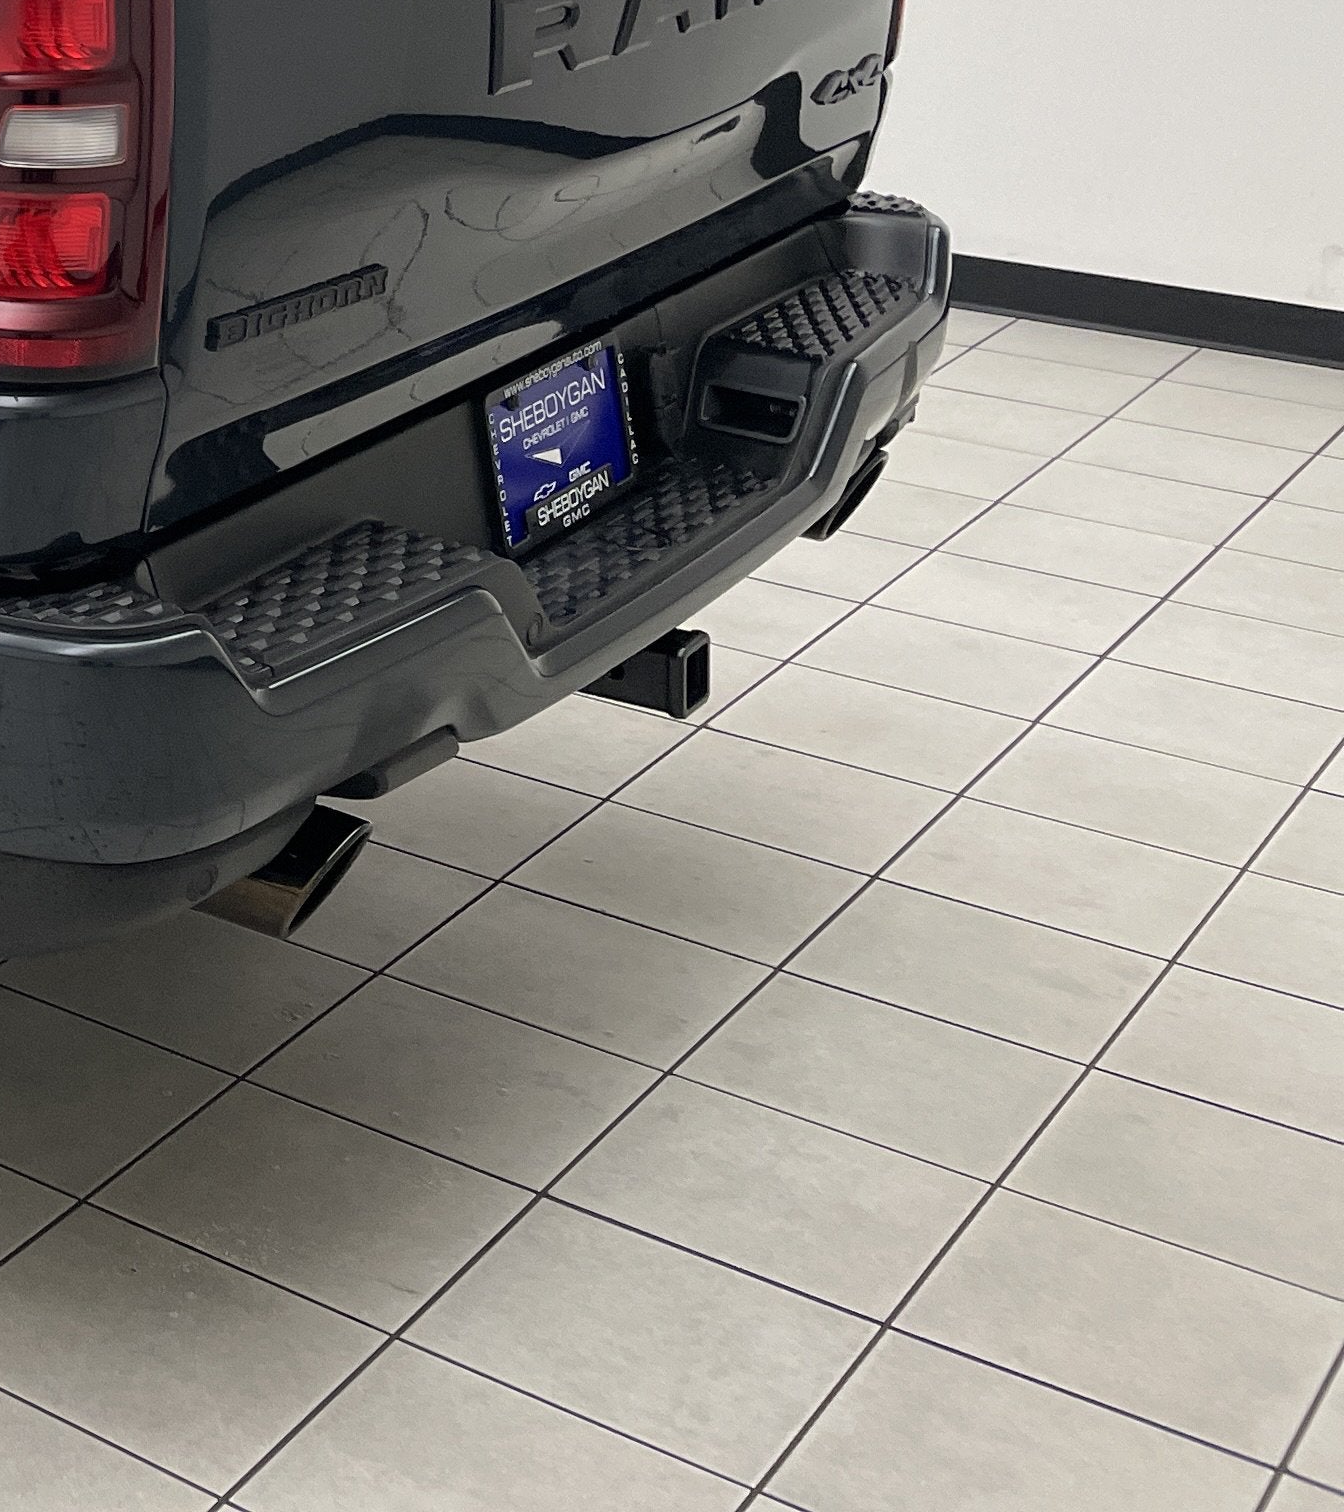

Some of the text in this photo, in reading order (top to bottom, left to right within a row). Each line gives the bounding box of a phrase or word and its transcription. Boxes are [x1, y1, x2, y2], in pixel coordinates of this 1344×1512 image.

[499, 367, 606, 443] SHEBOYGAN
[522, 405, 590, 450] CHEVROLET GMC
[616, 352, 639, 465] CADILLAC
[488, 413, 512, 547] CHEVROLET
[537, 470, 610, 527] SHEBOYGAN
[568, 460, 592, 482] GMC
[562, 503, 591, 528] GMC
